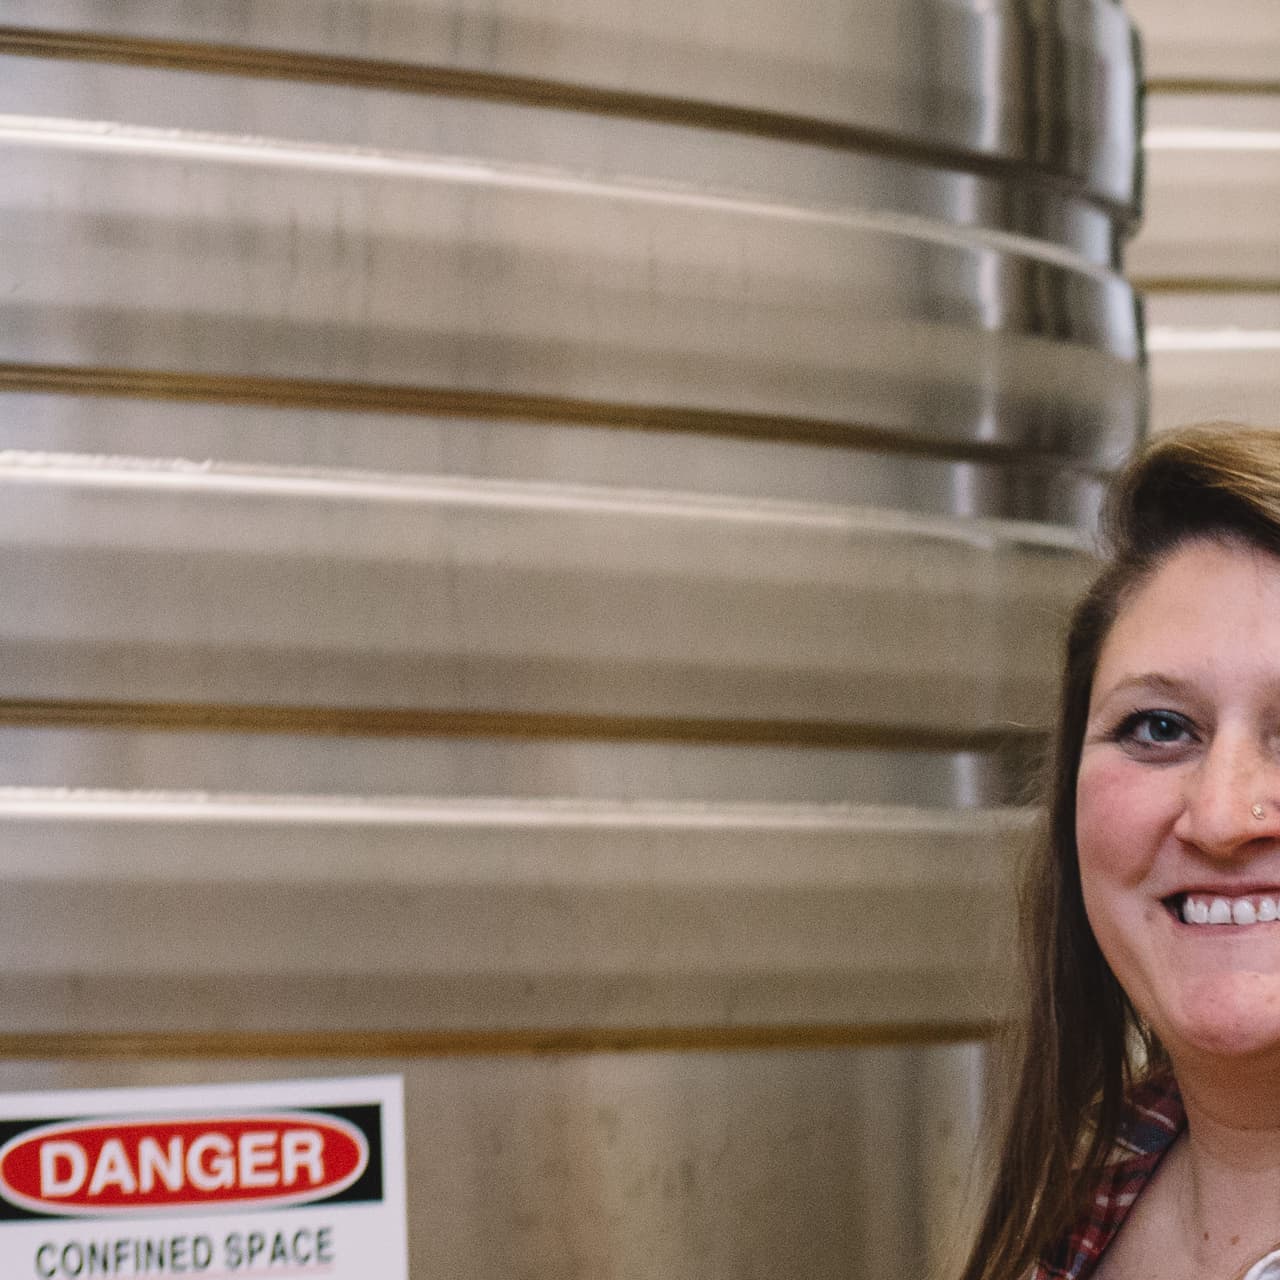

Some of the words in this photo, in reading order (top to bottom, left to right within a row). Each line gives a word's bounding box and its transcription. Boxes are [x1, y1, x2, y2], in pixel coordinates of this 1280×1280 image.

[39, 1130, 325, 1199] DANGER
[35, 1235, 214, 1280] CONFINED
[224, 1227, 334, 1269] SPACE
